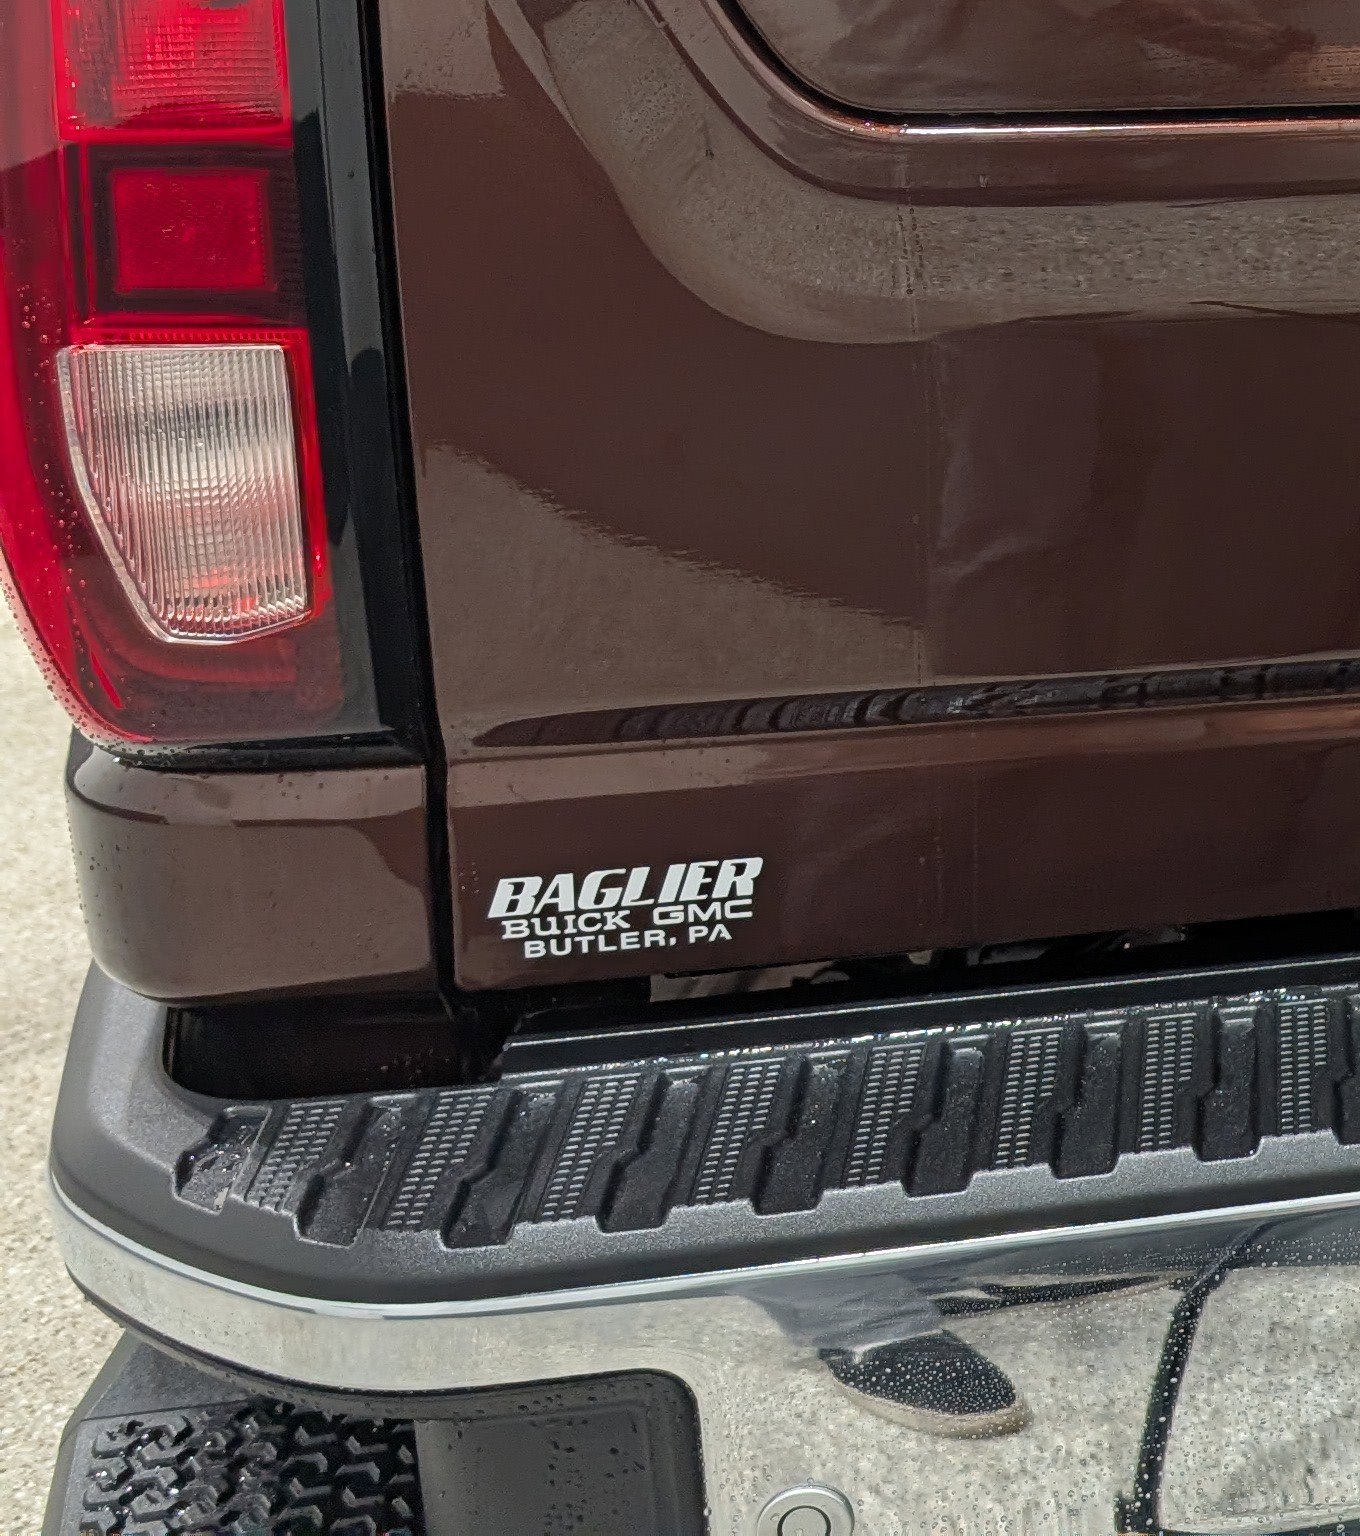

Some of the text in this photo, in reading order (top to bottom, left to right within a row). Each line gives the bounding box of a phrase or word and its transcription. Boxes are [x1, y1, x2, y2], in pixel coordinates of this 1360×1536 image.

[487, 856, 764, 919] BAGLIER
[500, 898, 753, 941] BUICK GMC
[523, 923, 733, 959] BUTLER, PA
